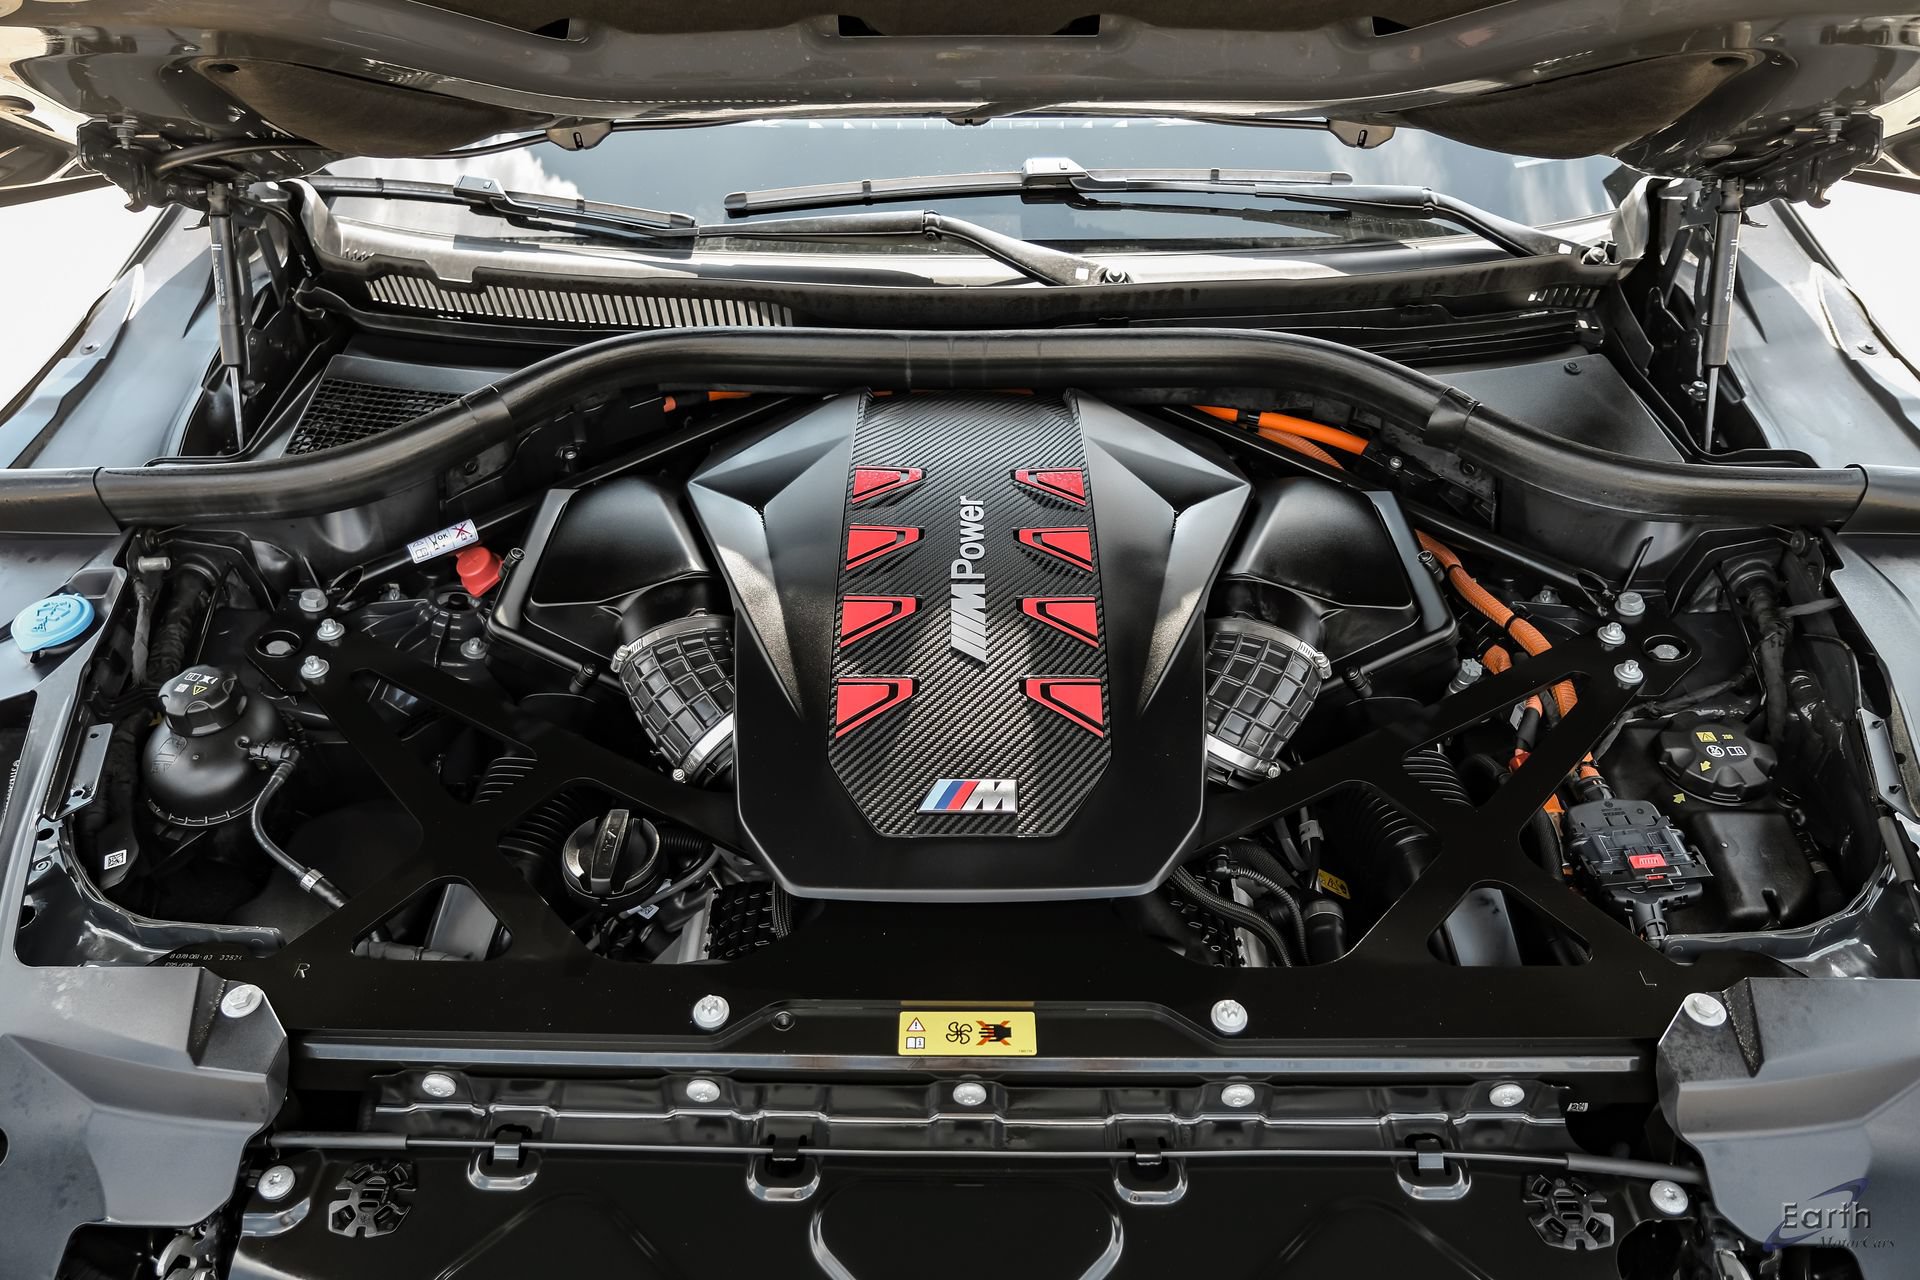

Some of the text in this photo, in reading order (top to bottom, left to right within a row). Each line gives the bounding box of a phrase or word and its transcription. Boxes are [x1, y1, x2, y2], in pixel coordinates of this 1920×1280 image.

[437, 532, 449, 541] OK
[958, 779, 1018, 812] M
[293, 962, 311, 979] R
